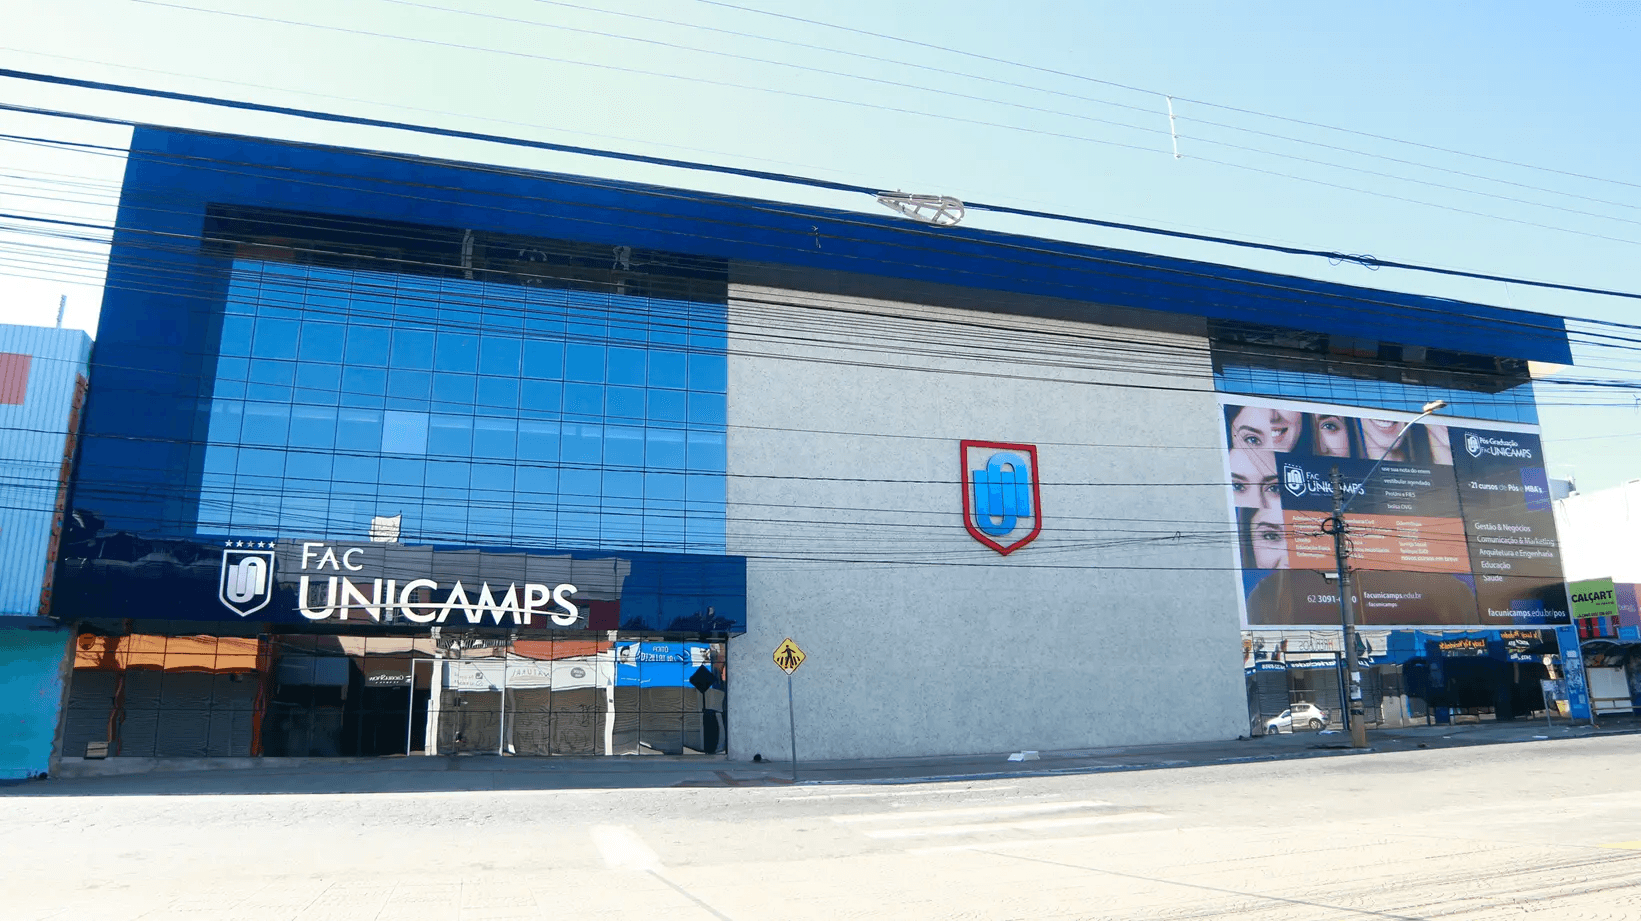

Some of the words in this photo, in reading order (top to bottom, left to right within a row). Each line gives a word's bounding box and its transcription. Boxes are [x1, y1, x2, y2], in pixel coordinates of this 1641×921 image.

[1508, 484, 1519, 492] Pós
[1475, 522, 1497, 532] Gestão
[1503, 523, 1531, 533] Negócios
[1477, 535, 1518, 545] Comunicação
[1524, 537, 1555, 547] Marketing
[301, 542, 364, 571] FAC
[1479, 548, 1514, 558] Arquitetura
[1520, 549, 1553, 559] Engenharia
[1481, 560, 1511, 570] Educação
[298, 576, 578, 626] UNICAMPS
[1307, 595, 1316, 603] 62
[1571, 590, 1613, 604] CALÇART
